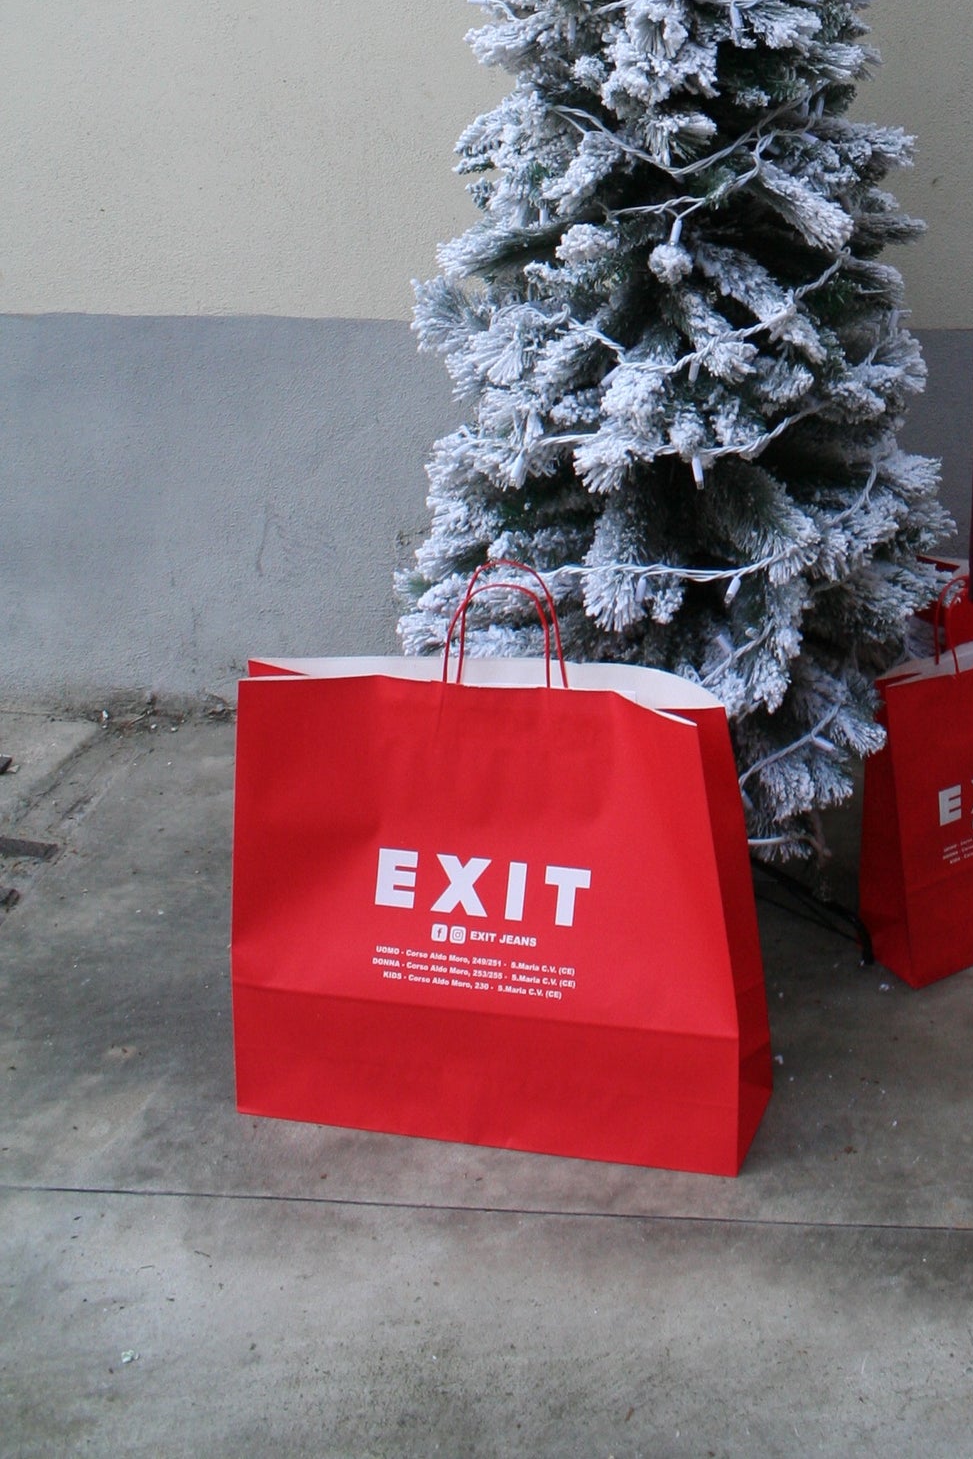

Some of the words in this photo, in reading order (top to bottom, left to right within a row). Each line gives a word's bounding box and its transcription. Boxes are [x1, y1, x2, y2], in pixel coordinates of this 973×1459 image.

[374, 848, 592, 927] EXIT
[470, 930, 497, 942] EXIT
[499, 934, 537, 947] JEANS
[372, 957, 400, 967] DONNA
[406, 961, 429, 971] Corso
[430, 964, 448, 973] Aldo
[449, 967, 471, 977] Moro,
[473, 969, 503, 980] 253/255
[512, 974, 540, 984] S.Maria
[542, 978, 558, 986] C.V.
[559, 979, 576, 989] (CE)
[376, 945, 400, 955] UOMO
[406, 949, 428, 959] Corso
[430, 952, 447, 961] Aldo
[448, 954, 470, 964] Moro,
[472, 957, 502, 967] 249/251
[510, 961, 540, 972] S.Maria
[541, 965, 557, 973] C.V.
[558, 967, 575, 976] (CE)
[383, 970, 402, 980] KIDS
[408, 974, 430, 983] Corso
[432, 977, 450, 986] Aldo
[451, 979, 472, 989] Moro,
[475, 982, 489, 990] 230
[498, 985, 527, 995] S.Maria
[528, 988, 544, 997] C.V.
[545, 990, 562, 1000] (CE)
